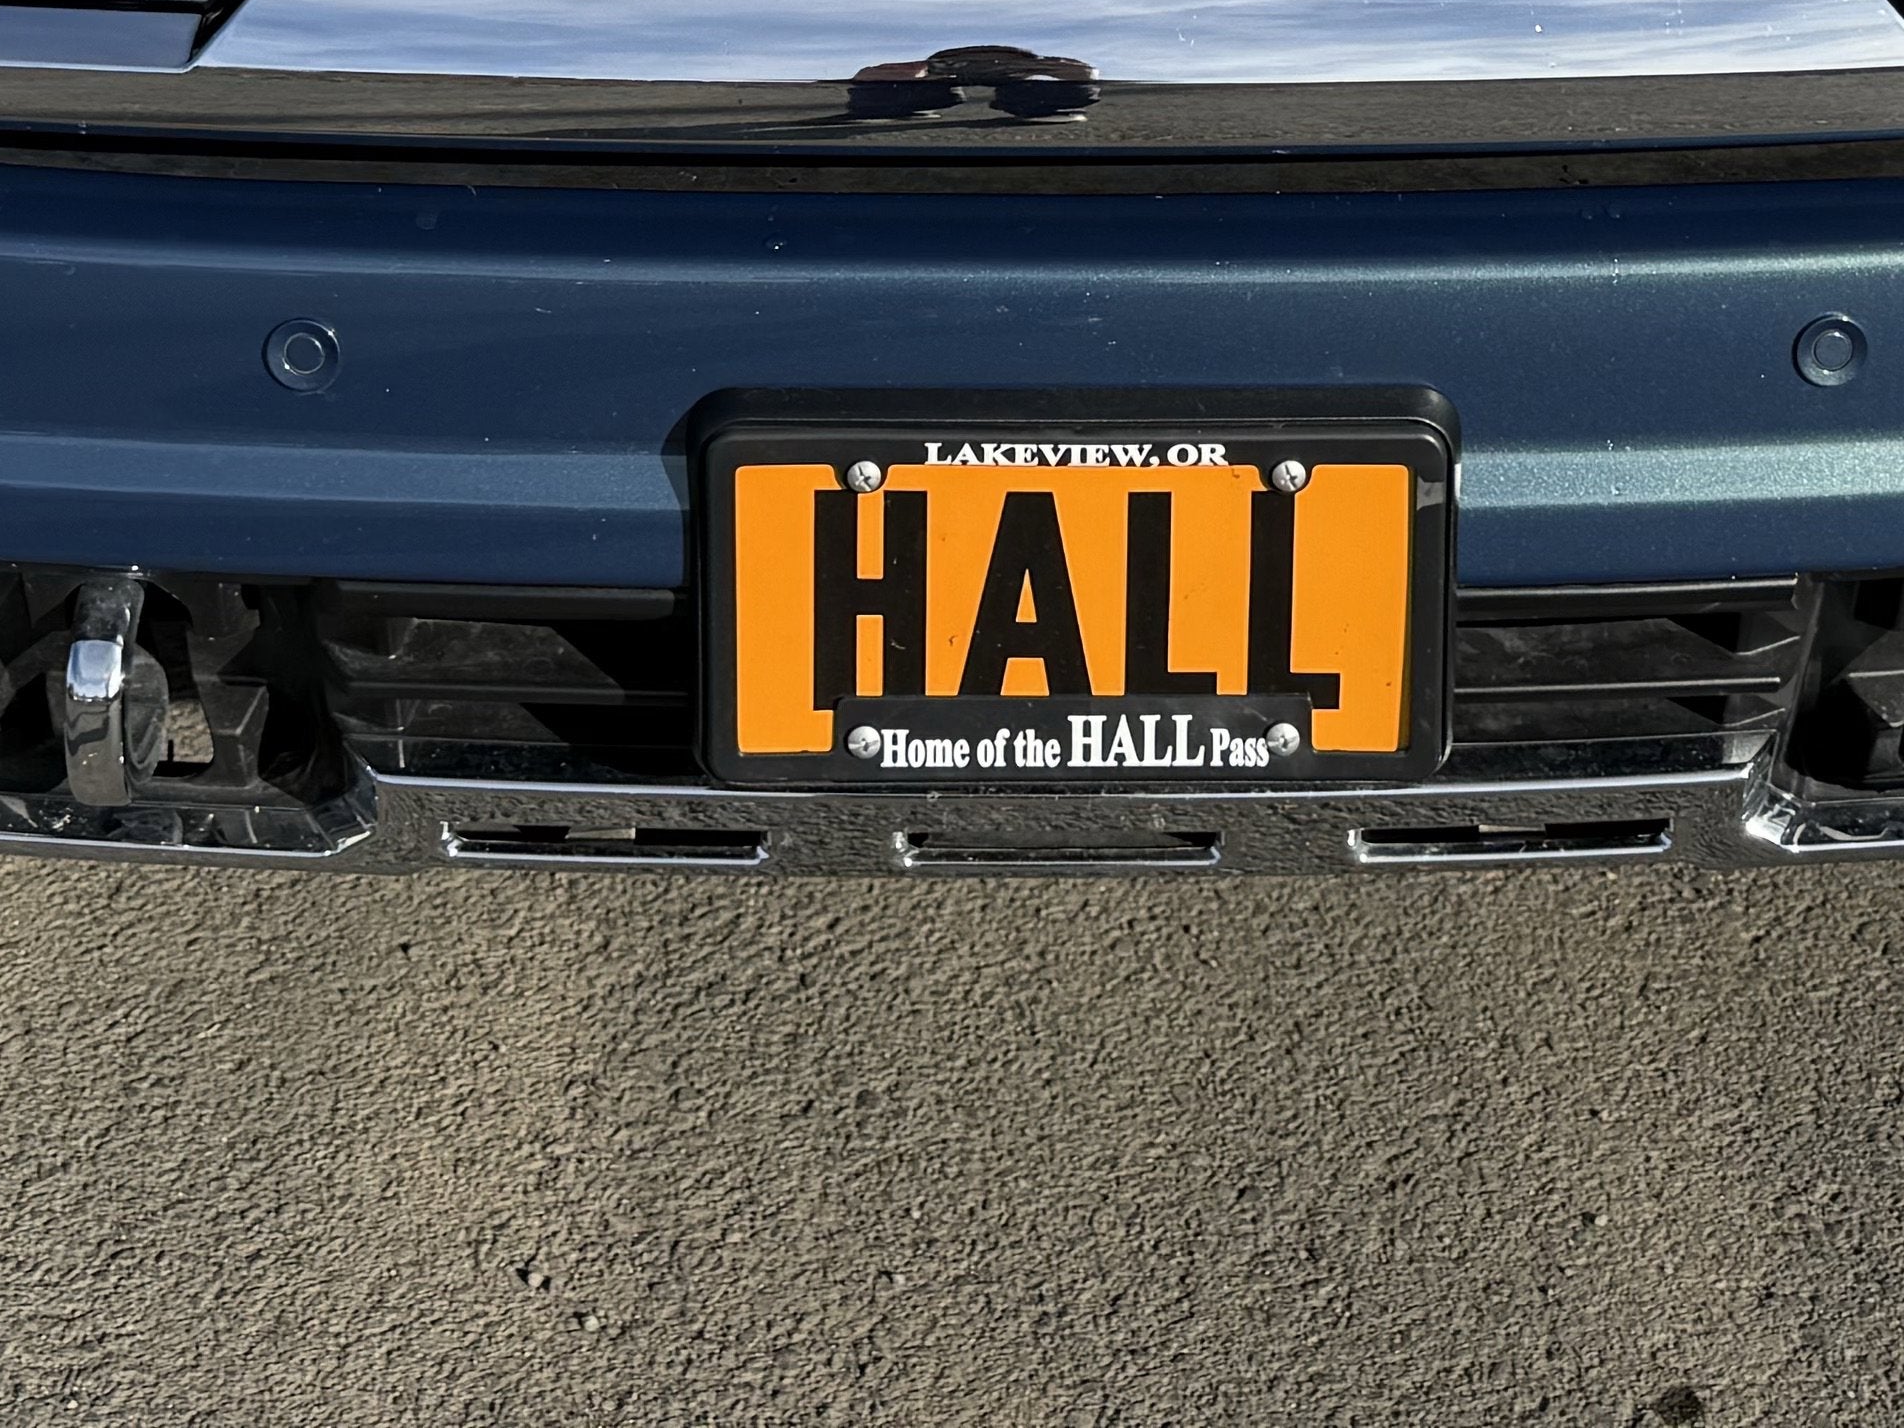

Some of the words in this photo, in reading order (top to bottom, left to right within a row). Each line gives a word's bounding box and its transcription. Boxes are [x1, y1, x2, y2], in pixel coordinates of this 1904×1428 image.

[924, 442, 1159, 467] LAKEVIEW,
[1167, 444, 1229, 467] OR
[813, 489, 1341, 711] HALL
[880, 729, 970, 767] Home
[976, 728, 1011, 767] of
[1013, 729, 1061, 767] the
[1067, 714, 1205, 767] HALL
[1210, 728, 1269, 768] Pass
